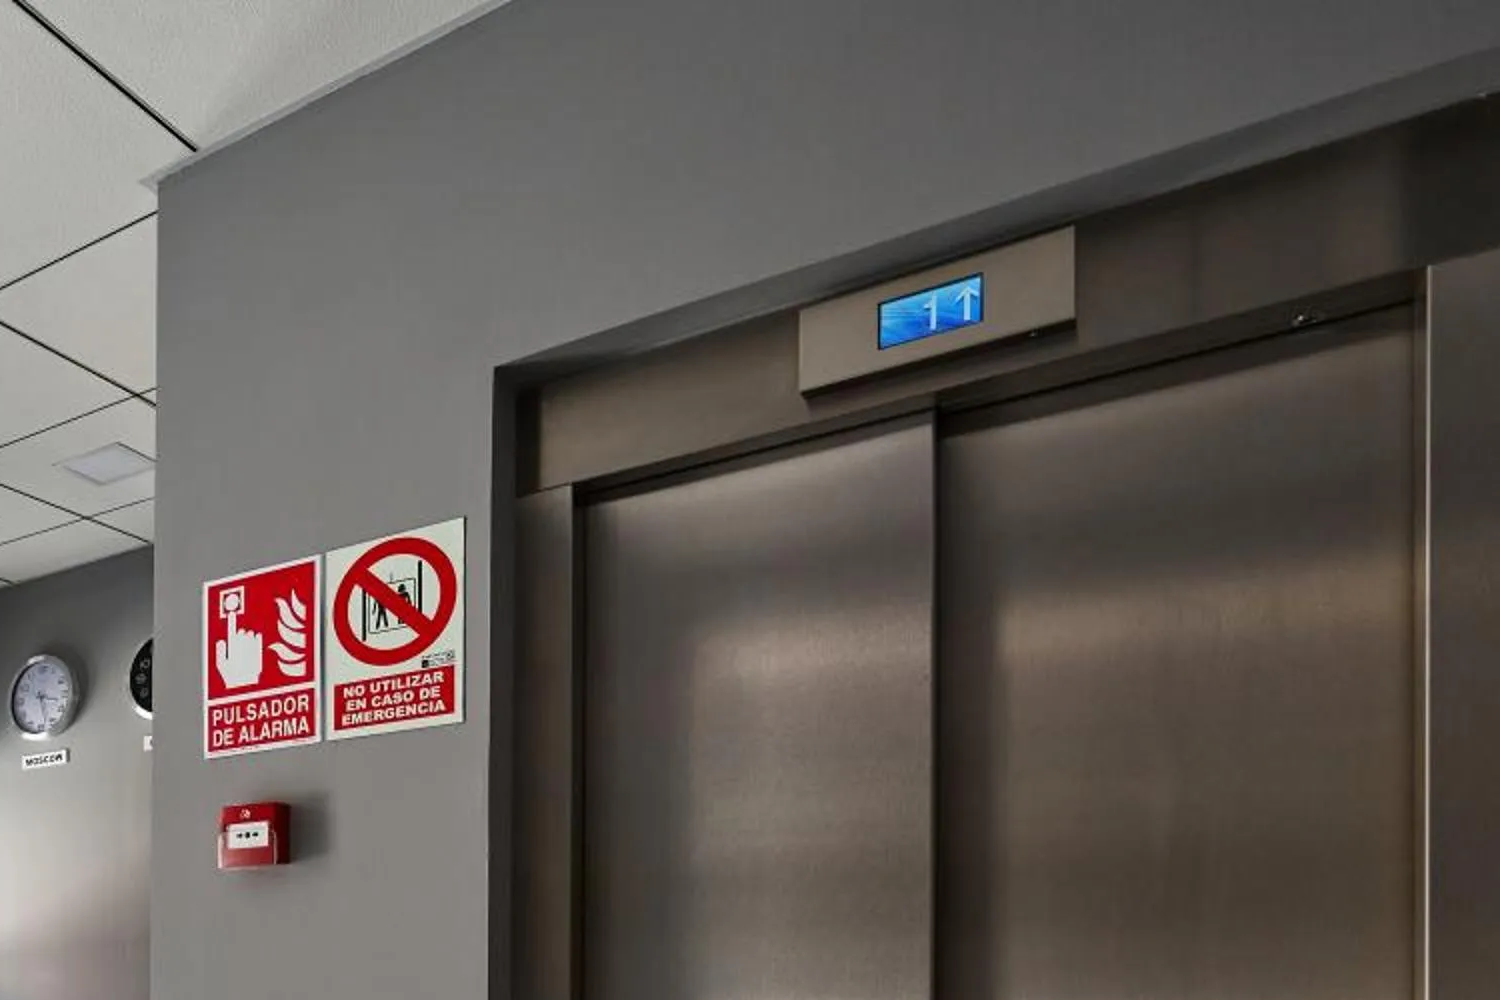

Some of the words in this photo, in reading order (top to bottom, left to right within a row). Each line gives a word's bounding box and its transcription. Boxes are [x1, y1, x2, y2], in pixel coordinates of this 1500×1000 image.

[923, 291, 938, 331] 1
[343, 684, 365, 699] NO
[370, 670, 445, 694] UTILIZAR
[345, 697, 368, 711] EN
[371, 691, 414, 707] CASO
[419, 686, 441, 701] DE
[212, 694, 310, 727] PULSADOR
[341, 699, 446, 727] EMERGENCIA
[212, 728, 234, 747] DE
[238, 715, 309, 744] ALARMA
